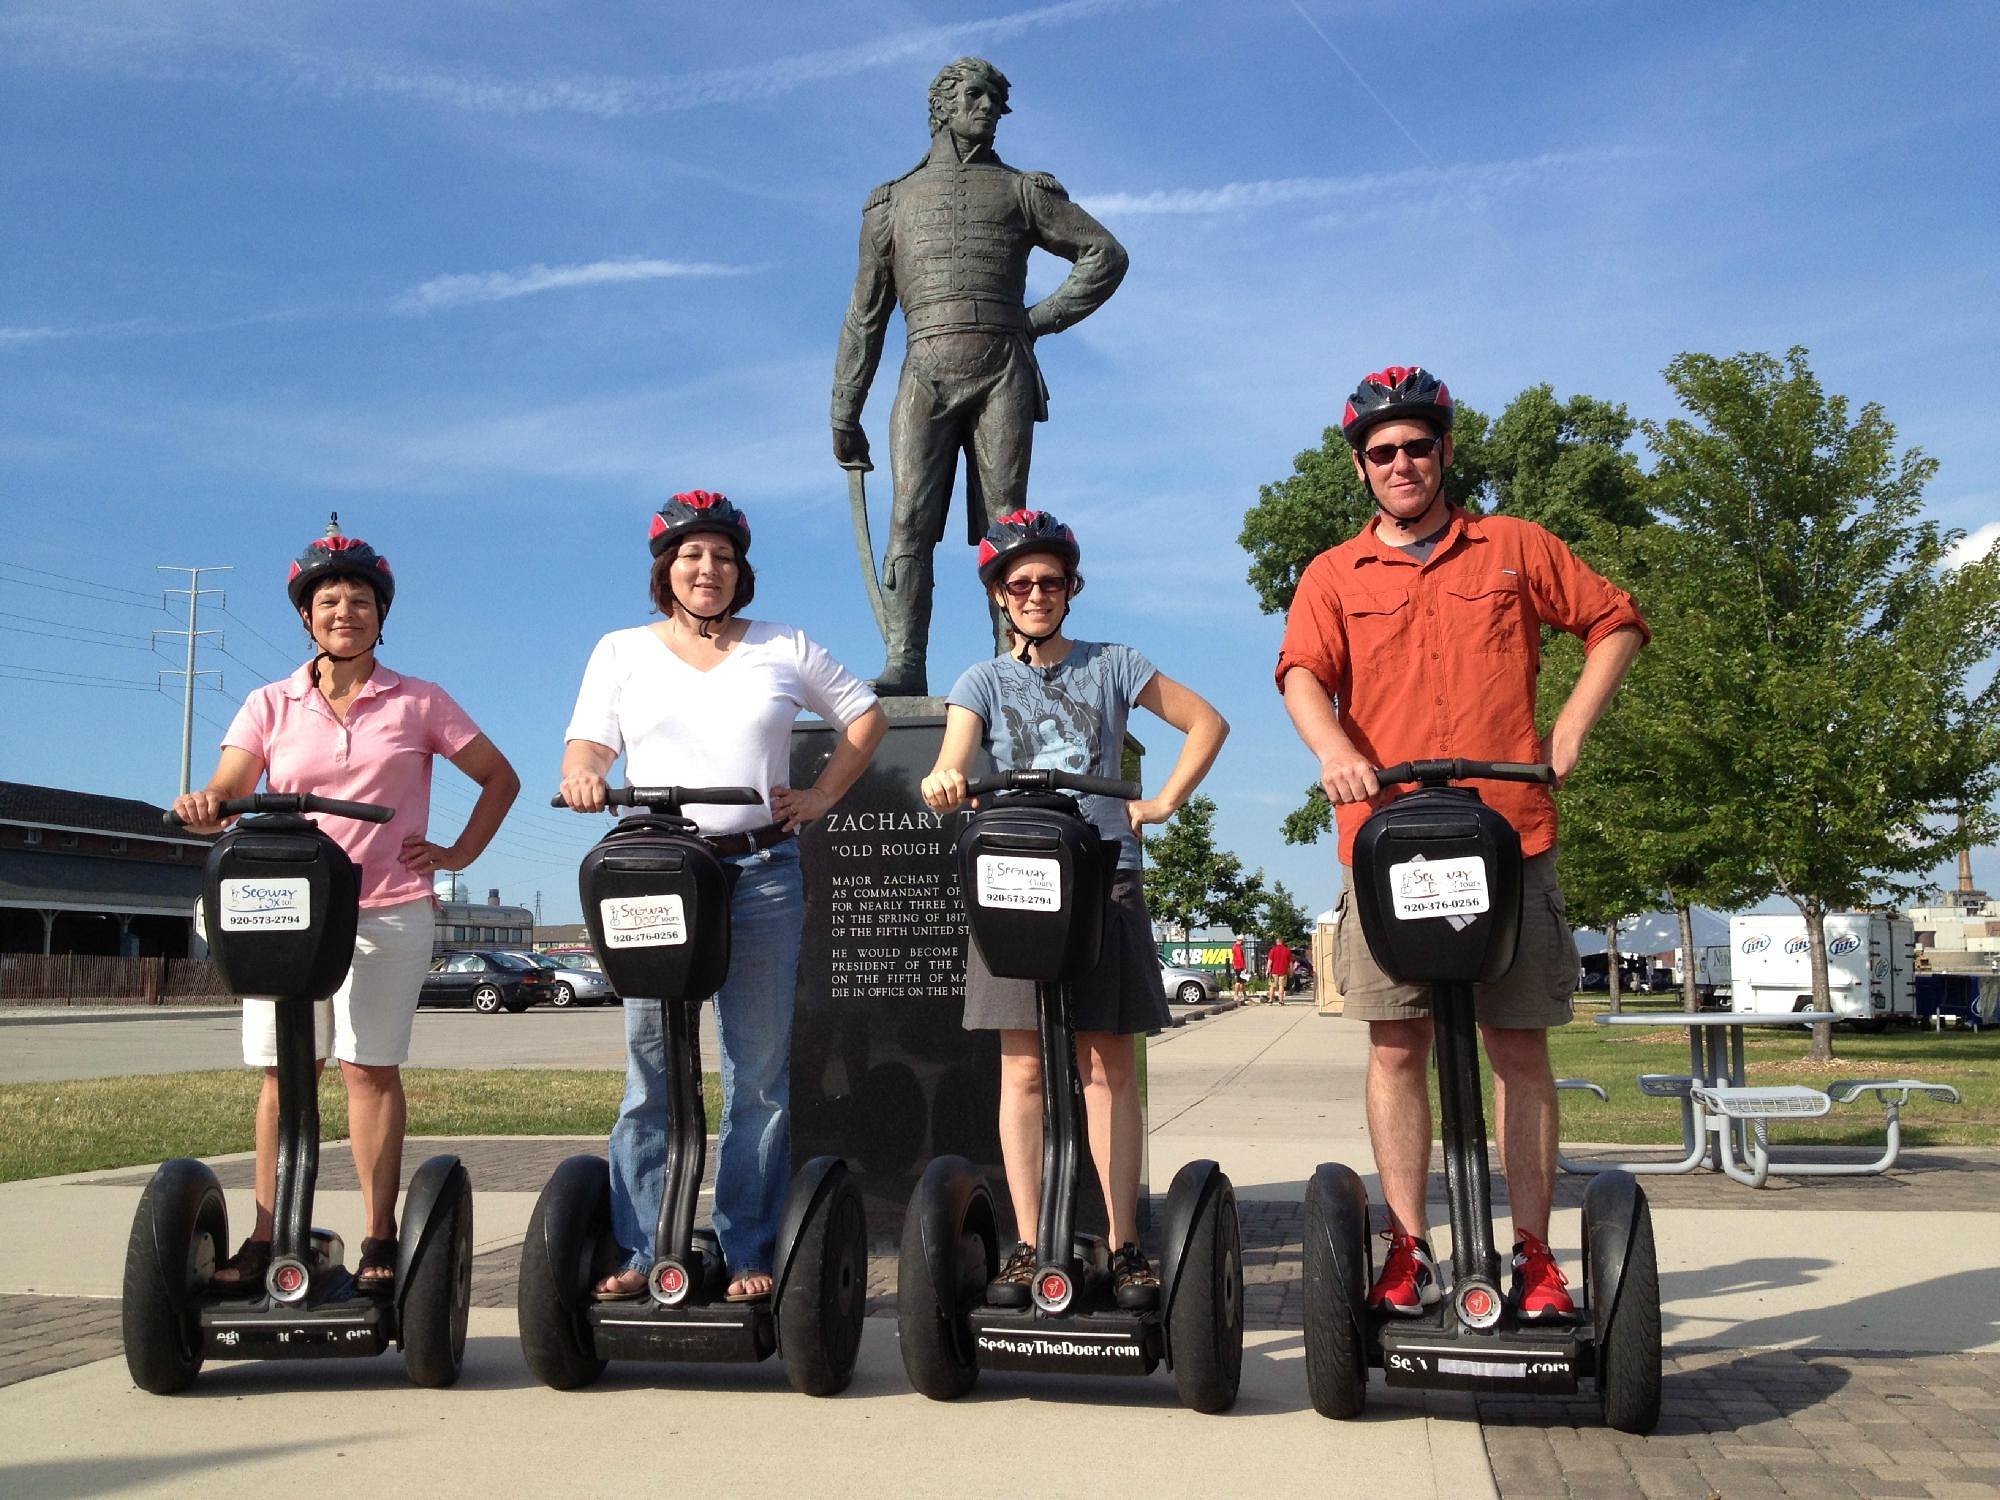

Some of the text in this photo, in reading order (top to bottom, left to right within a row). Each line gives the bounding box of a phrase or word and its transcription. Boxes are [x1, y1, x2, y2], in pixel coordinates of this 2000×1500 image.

[827, 811, 944, 832] ZACHARY
[881, 843, 939, 856] ROUGH
[832, 876, 872, 887] MAJOR
[883, 874, 940, 885] ZACHARY
[832, 889, 847, 899] AS
[854, 887, 939, 898] COMMANDANT
[986, 893, 1052, 905] 920-573-2794
[832, 902, 853, 912] FOR
[859, 901, 903, 911] NEARLY
[909, 900, 946, 910] THREE
[1403, 898, 1480, 912] 920-376-0256
[230, 915, 300, 925] 920-573-2794
[832, 915, 845, 925] IN
[850, 914, 873, 924] THE
[878, 913, 919, 924] SPRING
[925, 912, 940, 922] OF
[831, 927, 846, 937] OF
[849, 927, 872, 937] THE
[876, 926, 907, 936] FIFTH
[912, 925, 954, 936] UNITED
[832, 947, 959, 958] HE WOULD BECOME
[832, 961, 896, 972] PRESIDENT
[904, 960, 920, 970] OF
[928, 960, 953, 970] THE
[831, 974, 849, 985] ON
[855, 974, 880, 984] THE
[887, 973, 921, 984] FIFTH
[929, 973, 944, 983] OF
[832, 987, 850, 998] DIE
[853, 987, 865, 997] IN
[868, 986, 905, 997] OFFICE
[907, 986, 924, 996] ON
[926, 986, 948, 996] THE
